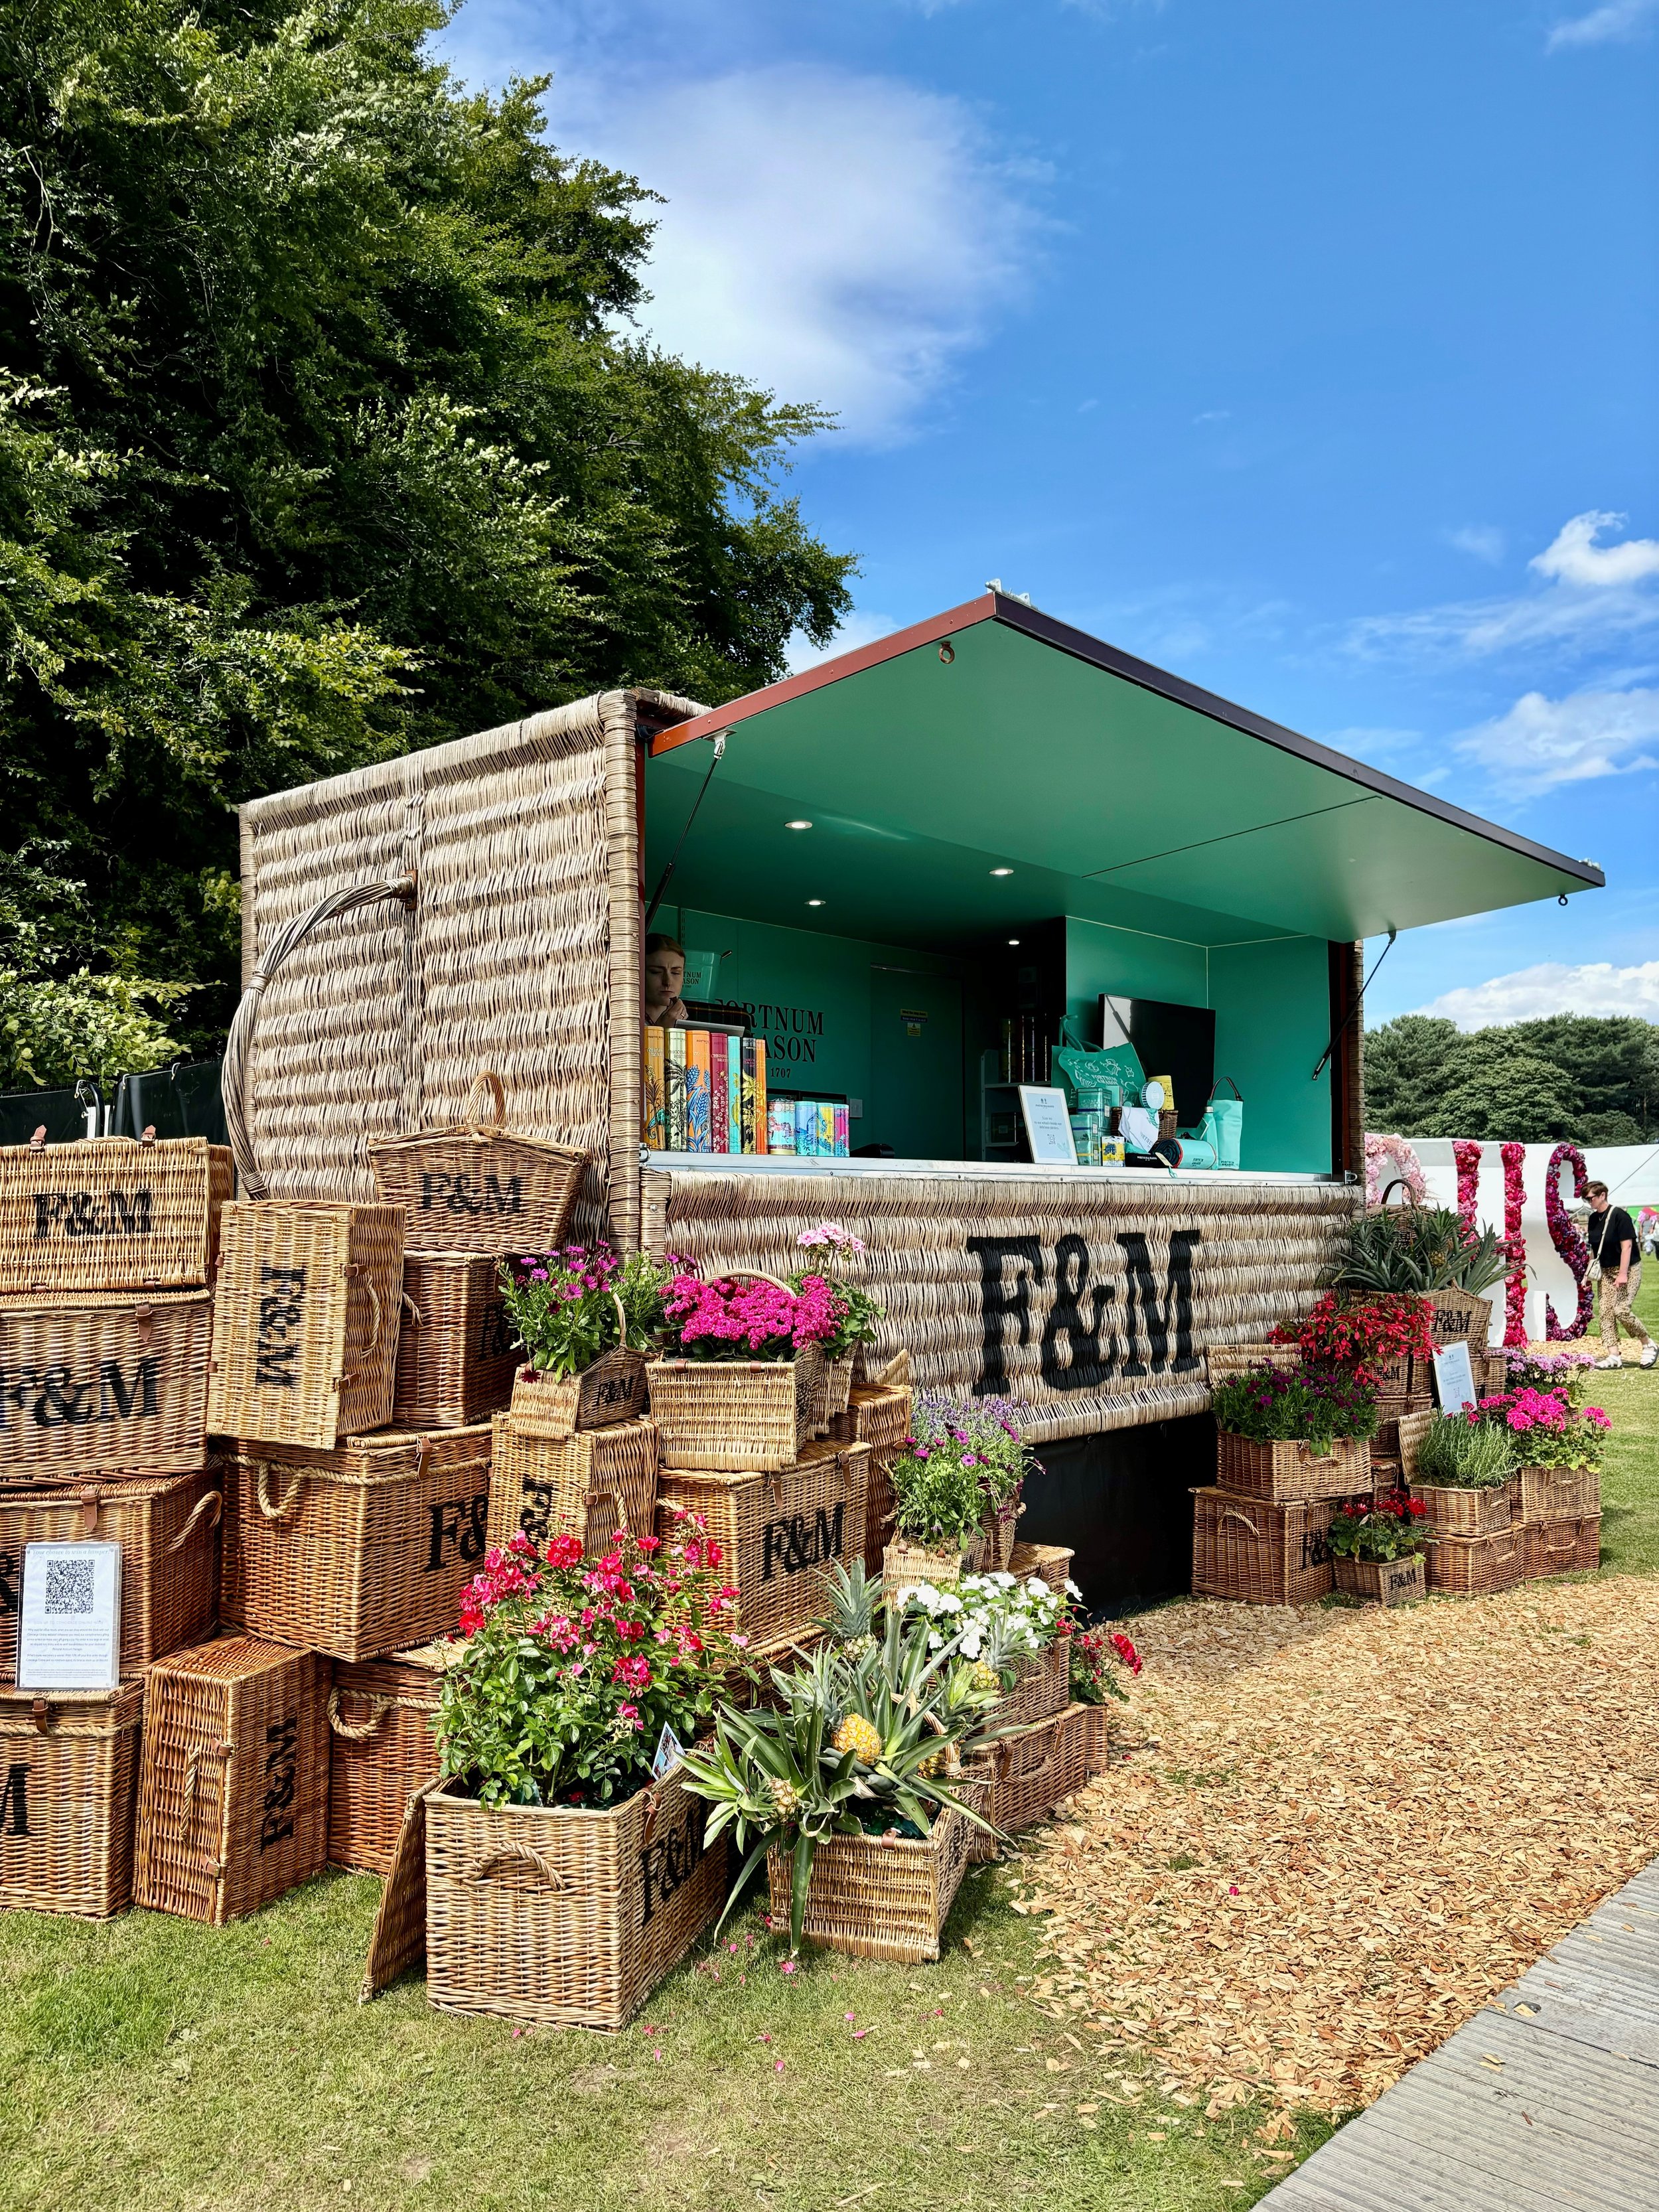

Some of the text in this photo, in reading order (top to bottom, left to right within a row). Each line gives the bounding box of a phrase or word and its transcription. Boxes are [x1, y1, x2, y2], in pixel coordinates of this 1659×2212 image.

[715, 999, 824, 1036] RTNUM
[752, 1032, 818, 1063] ASON
[770, 1067, 791, 1078] 1707
[33, 1189, 154, 1239] F&M
[419, 1173, 522, 1215] F&M
[255, 1265, 307, 1388] F&M
[967, 1229, 1200, 1396] F&M
[1430, 1309, 1472, 1333] F&M
[595, 1375, 634, 1406] F&M
[424, 1494, 488, 1572] F&
[762, 1502, 846, 1581] F&M
[1390, 1568, 1417, 1590] F&M
[260, 1716, 297, 1855] F&M
